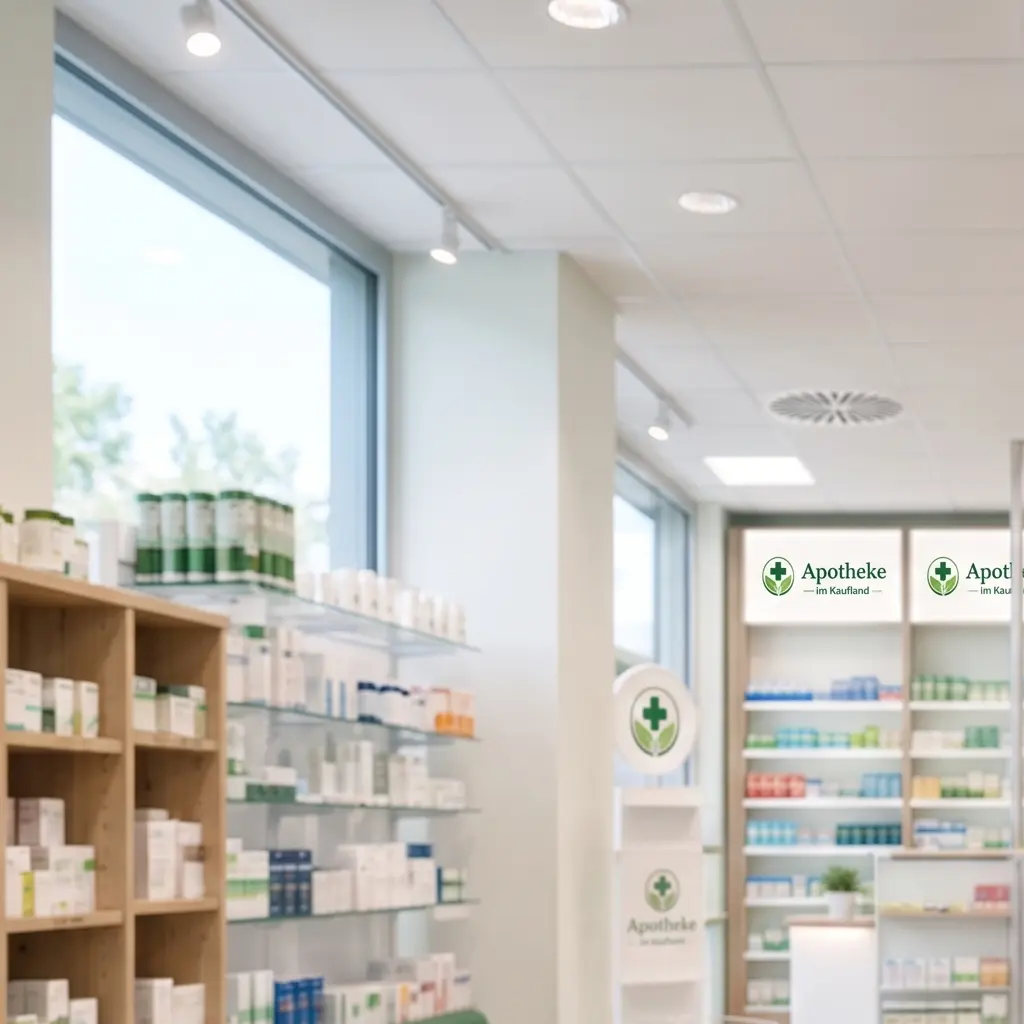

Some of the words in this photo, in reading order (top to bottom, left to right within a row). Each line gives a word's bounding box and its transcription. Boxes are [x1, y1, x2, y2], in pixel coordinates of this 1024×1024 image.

[801, 562, 887, 584] Apotheke
[816, 586, 828, 595] im
[830, 586, 870, 595] Kaufland
[980, 586, 992, 595] im
